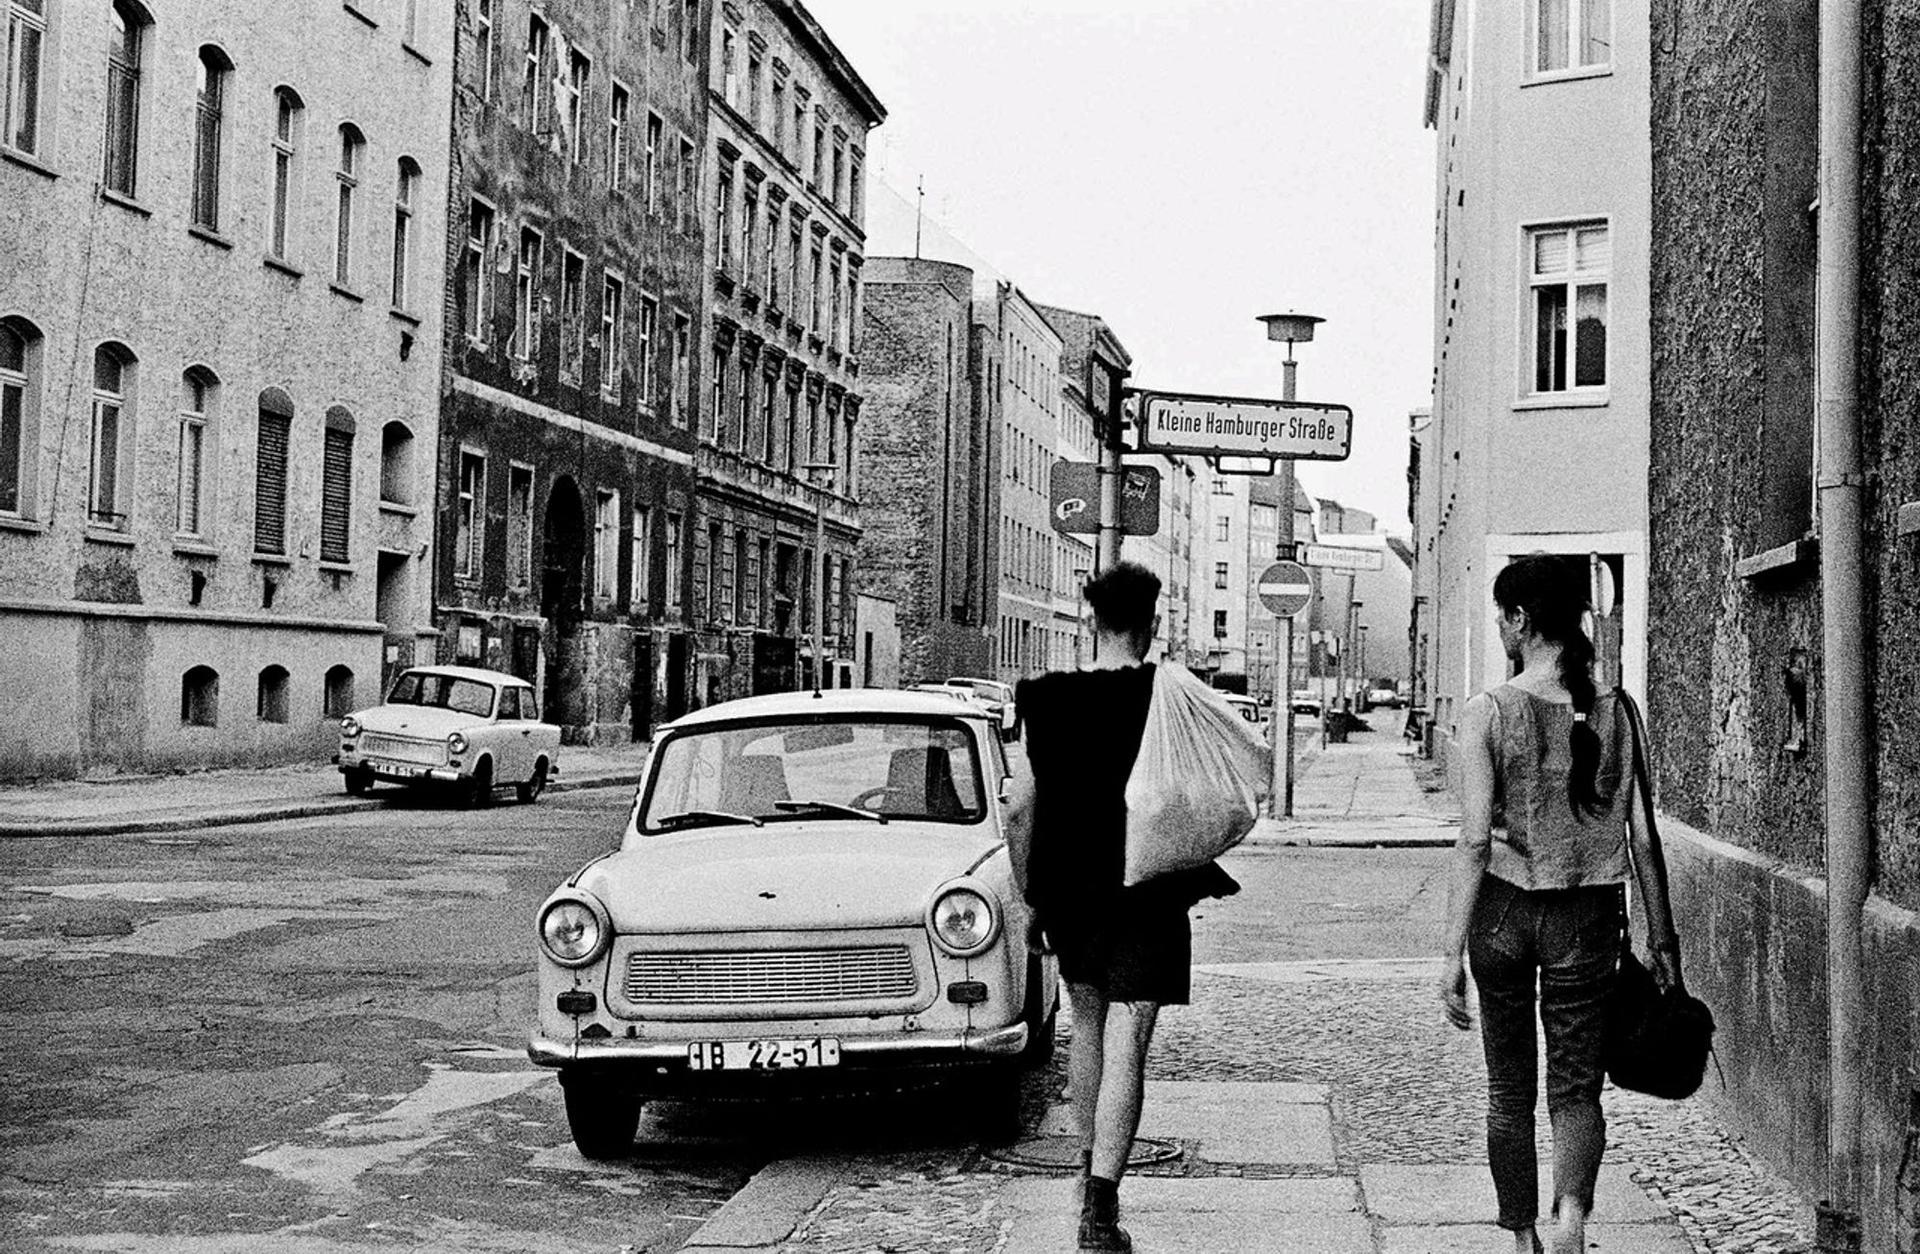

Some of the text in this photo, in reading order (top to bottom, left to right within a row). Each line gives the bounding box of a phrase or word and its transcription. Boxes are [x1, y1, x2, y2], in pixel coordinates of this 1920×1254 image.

[1157, 409, 1335, 443] Kleine Hamburger Straße
[748, 1039, 822, 1069] 22-51
